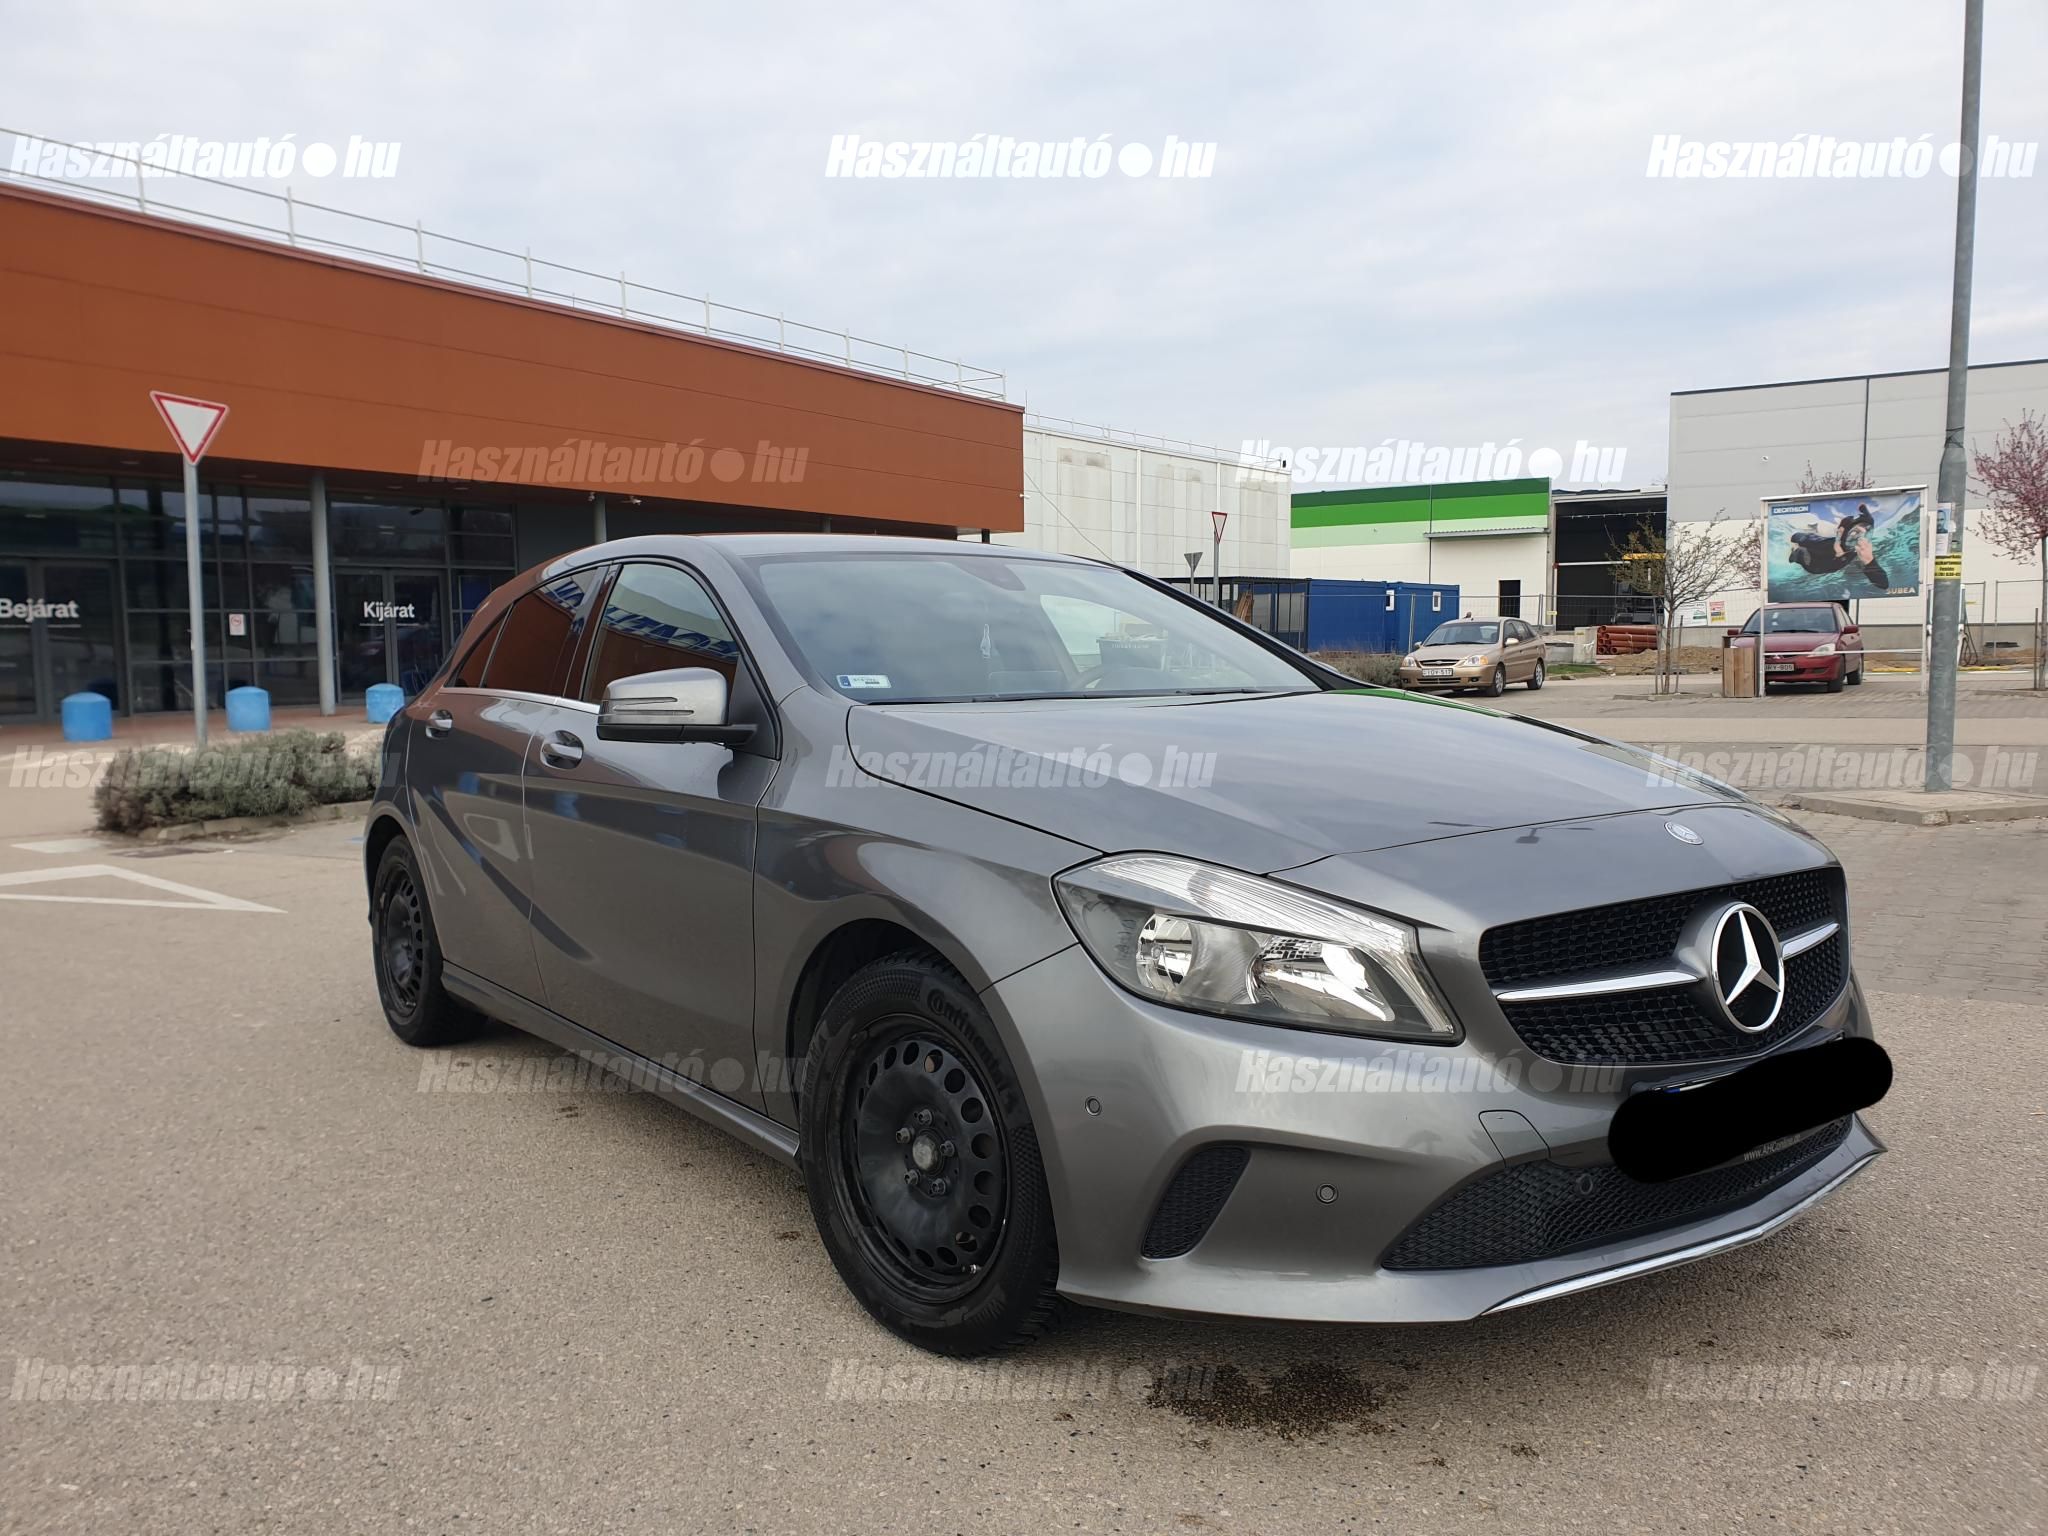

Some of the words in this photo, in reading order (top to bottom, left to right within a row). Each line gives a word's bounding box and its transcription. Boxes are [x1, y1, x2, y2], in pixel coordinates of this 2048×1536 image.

[1773, 506, 1809, 514] DECATHLON
[0, 598, 80, 623] Bejárat
[363, 601, 415, 622] Kijárat
[928, 988, 1009, 1096] Continental
